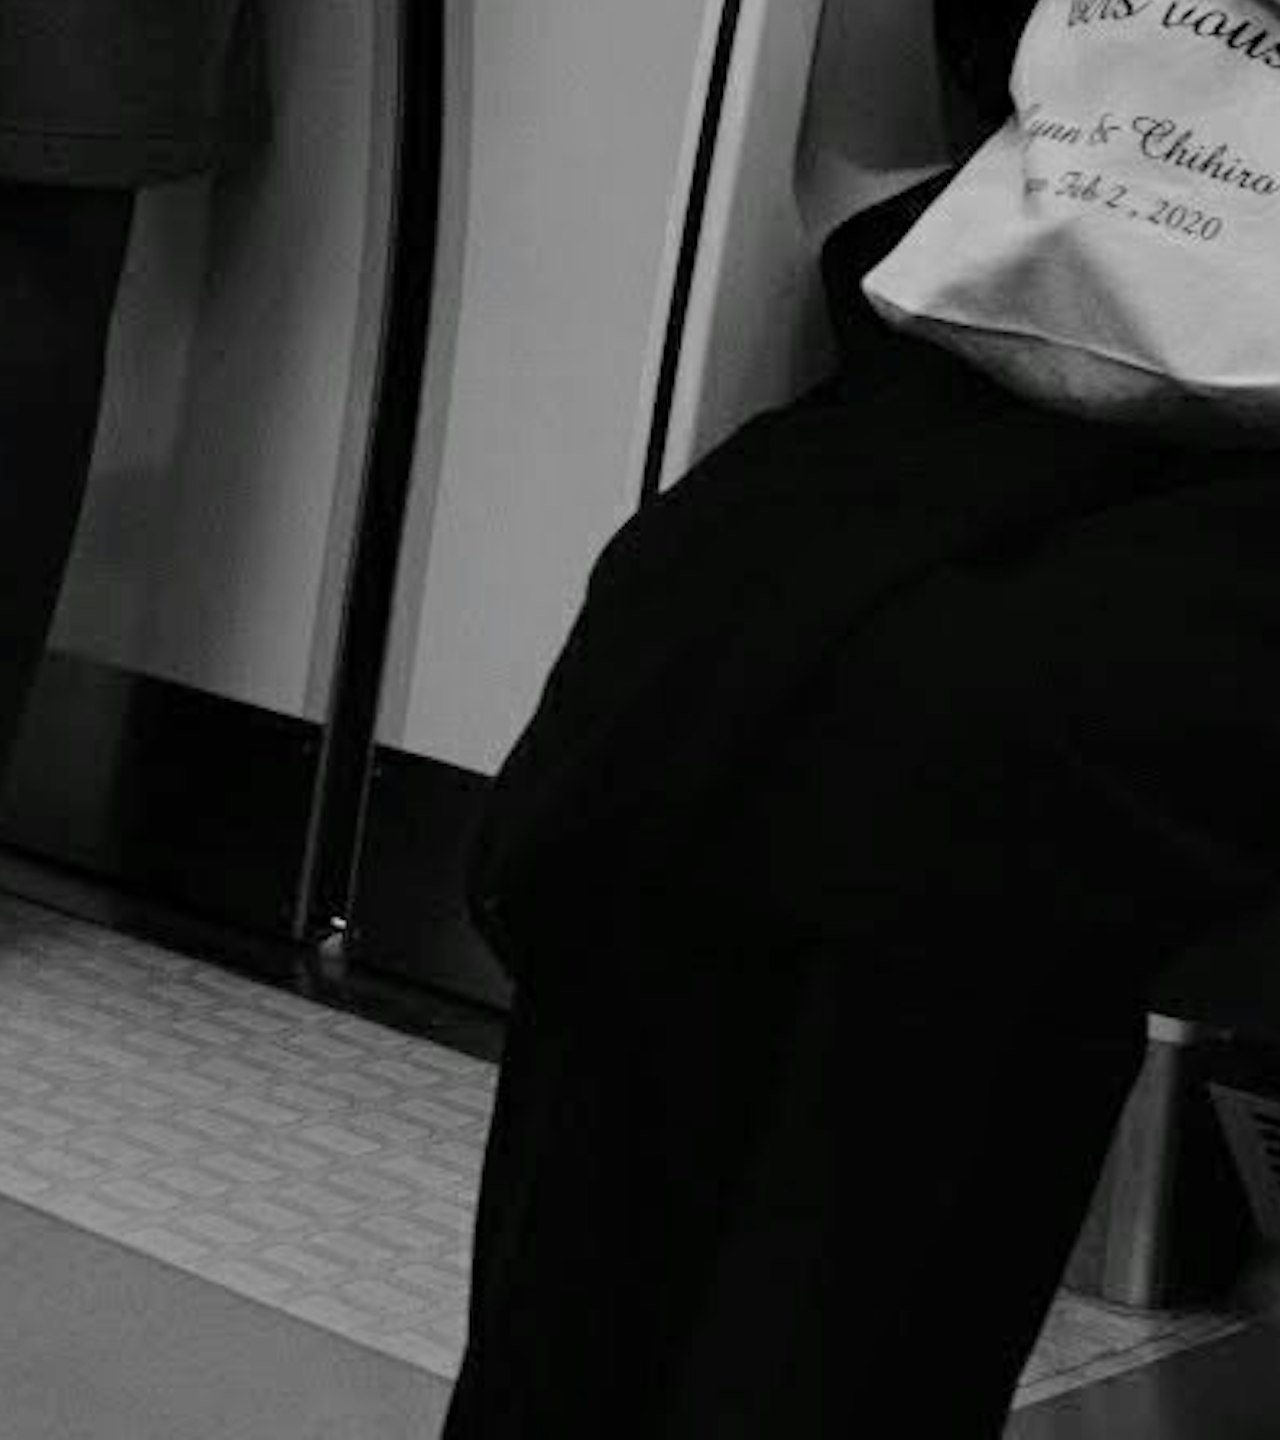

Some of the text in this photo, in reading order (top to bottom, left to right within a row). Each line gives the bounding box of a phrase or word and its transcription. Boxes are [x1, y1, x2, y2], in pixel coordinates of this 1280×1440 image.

[1089, 112, 1123, 145] &
[1055, 171, 1103, 202] Feb
[1146, 200, 1224, 241] 2020
